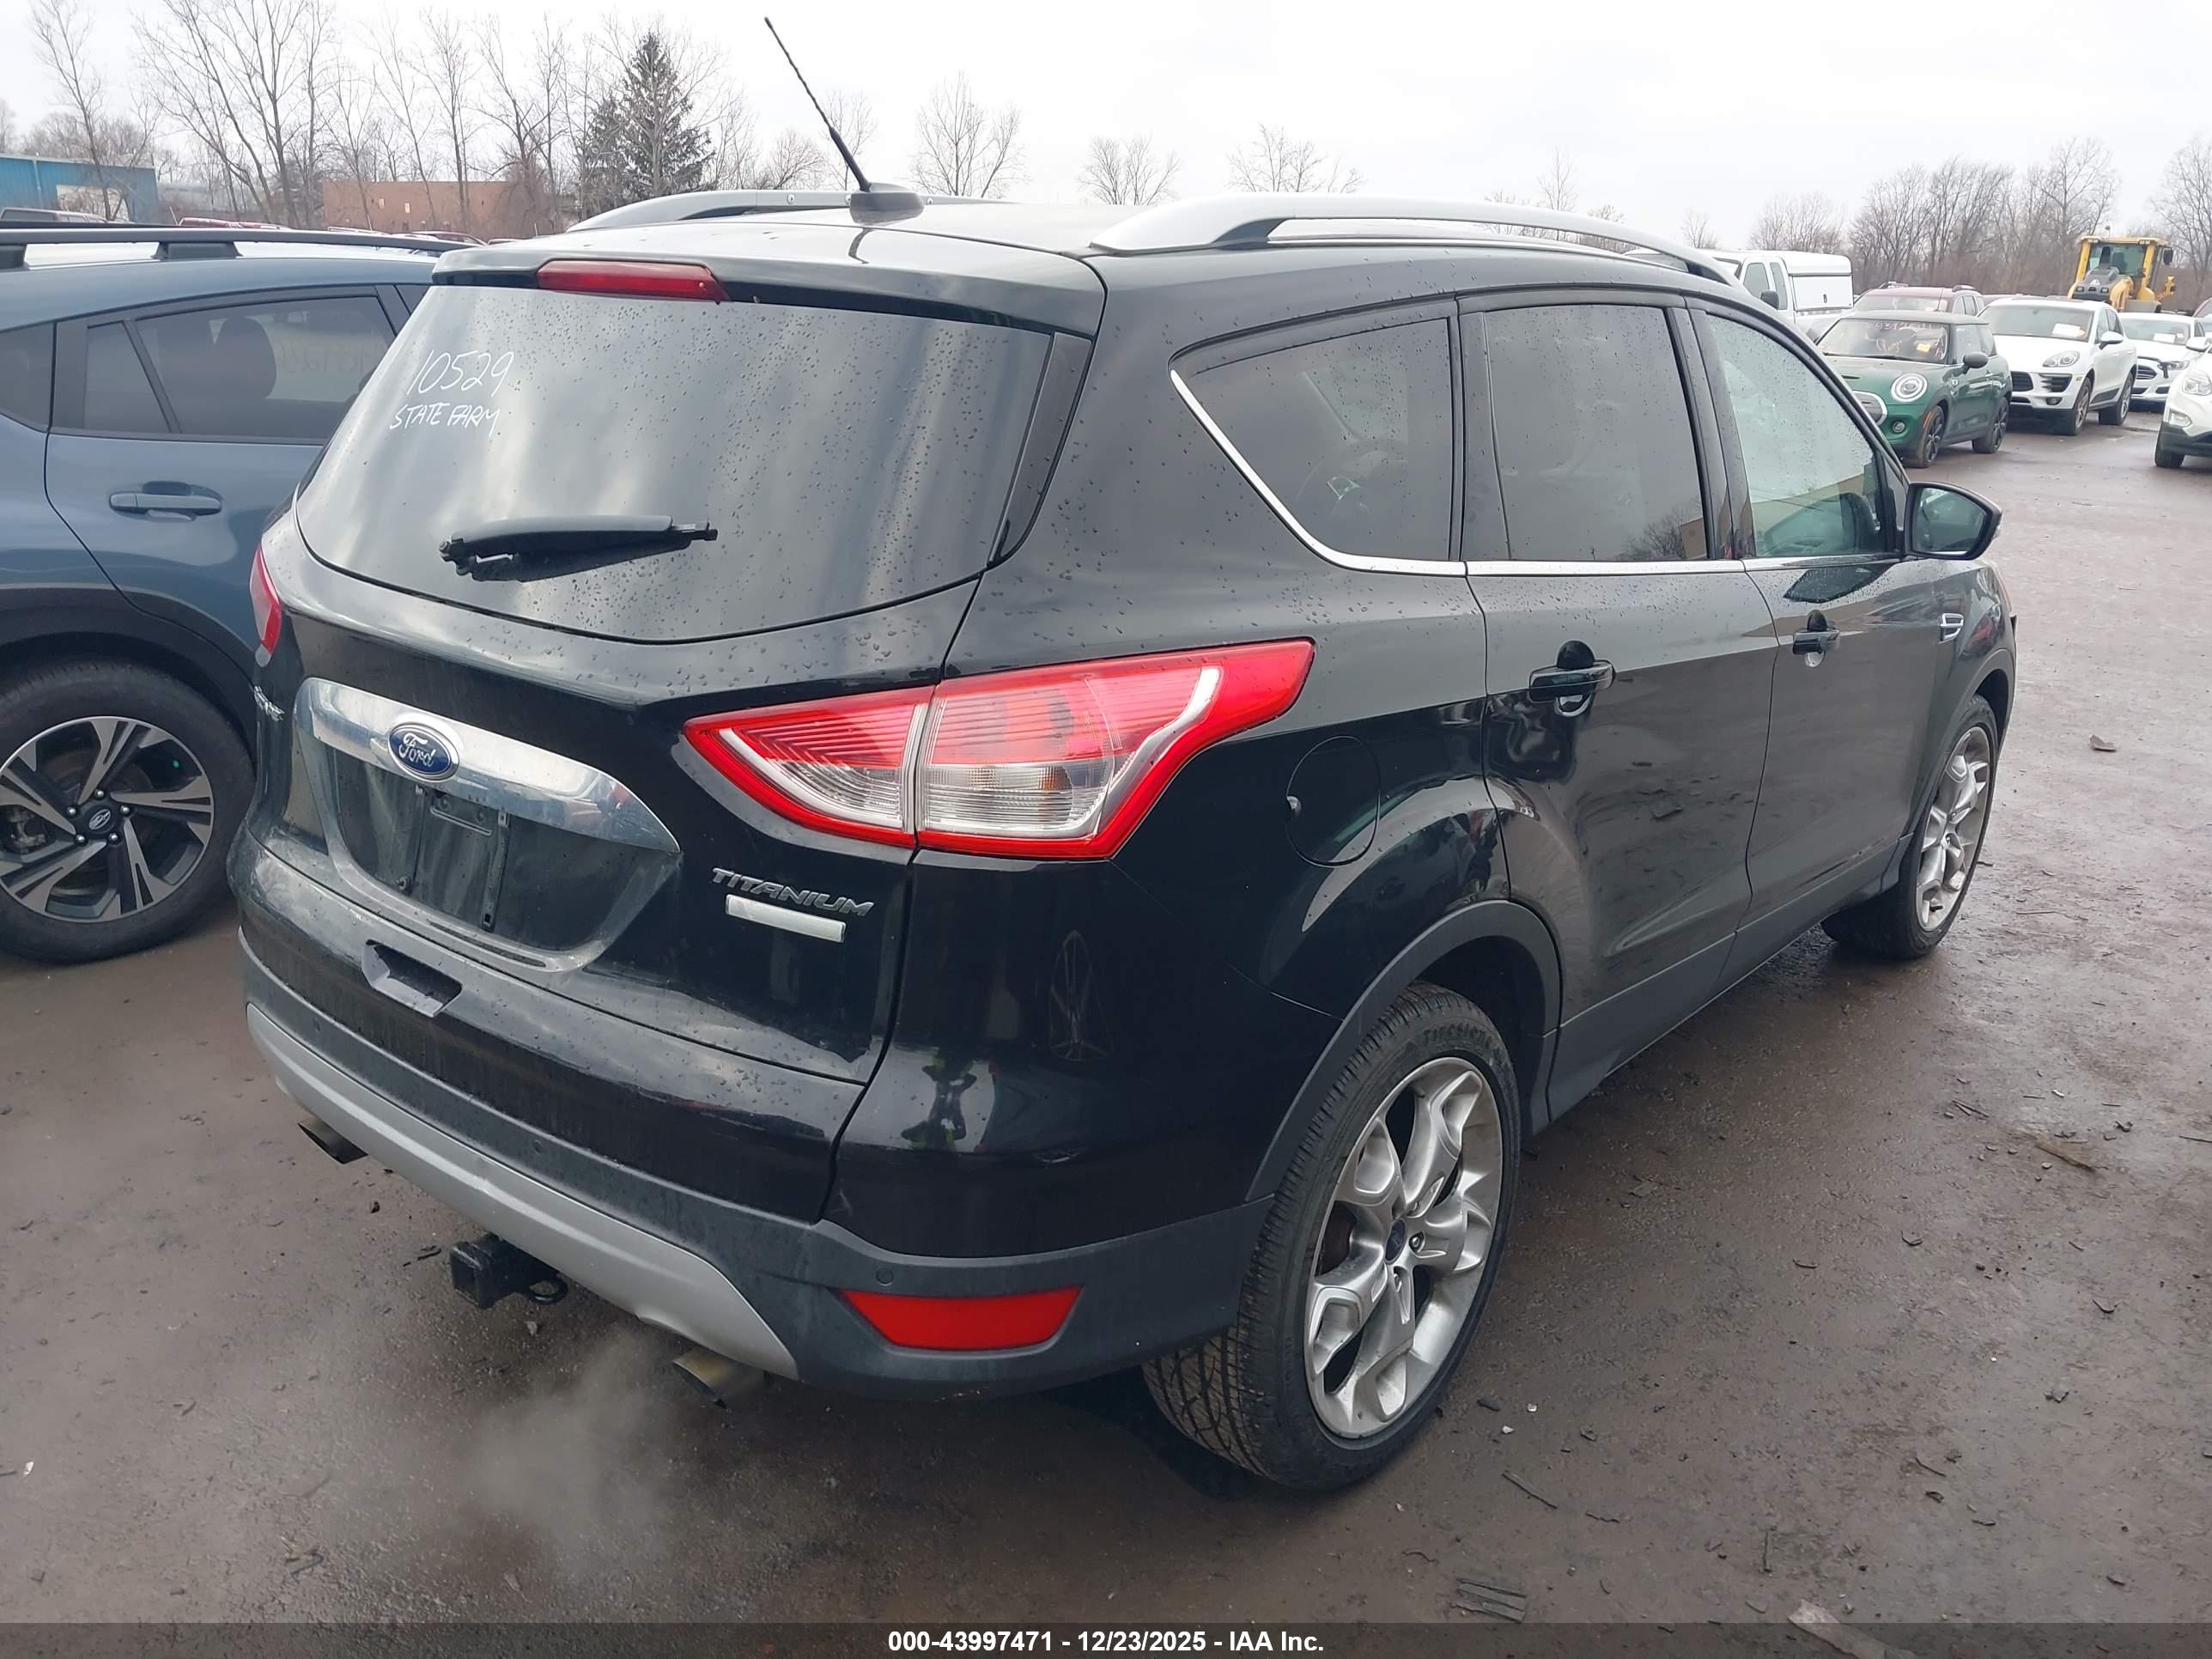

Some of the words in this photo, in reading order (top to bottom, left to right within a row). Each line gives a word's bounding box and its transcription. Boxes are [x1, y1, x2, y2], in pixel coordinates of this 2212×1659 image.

[406, 349, 514, 398] 10529
[389, 402, 451, 429] STATE
[447, 404, 501, 437] FARM
[398, 732, 437, 767] Ford
[711, 866, 875, 917] TITANIUM
